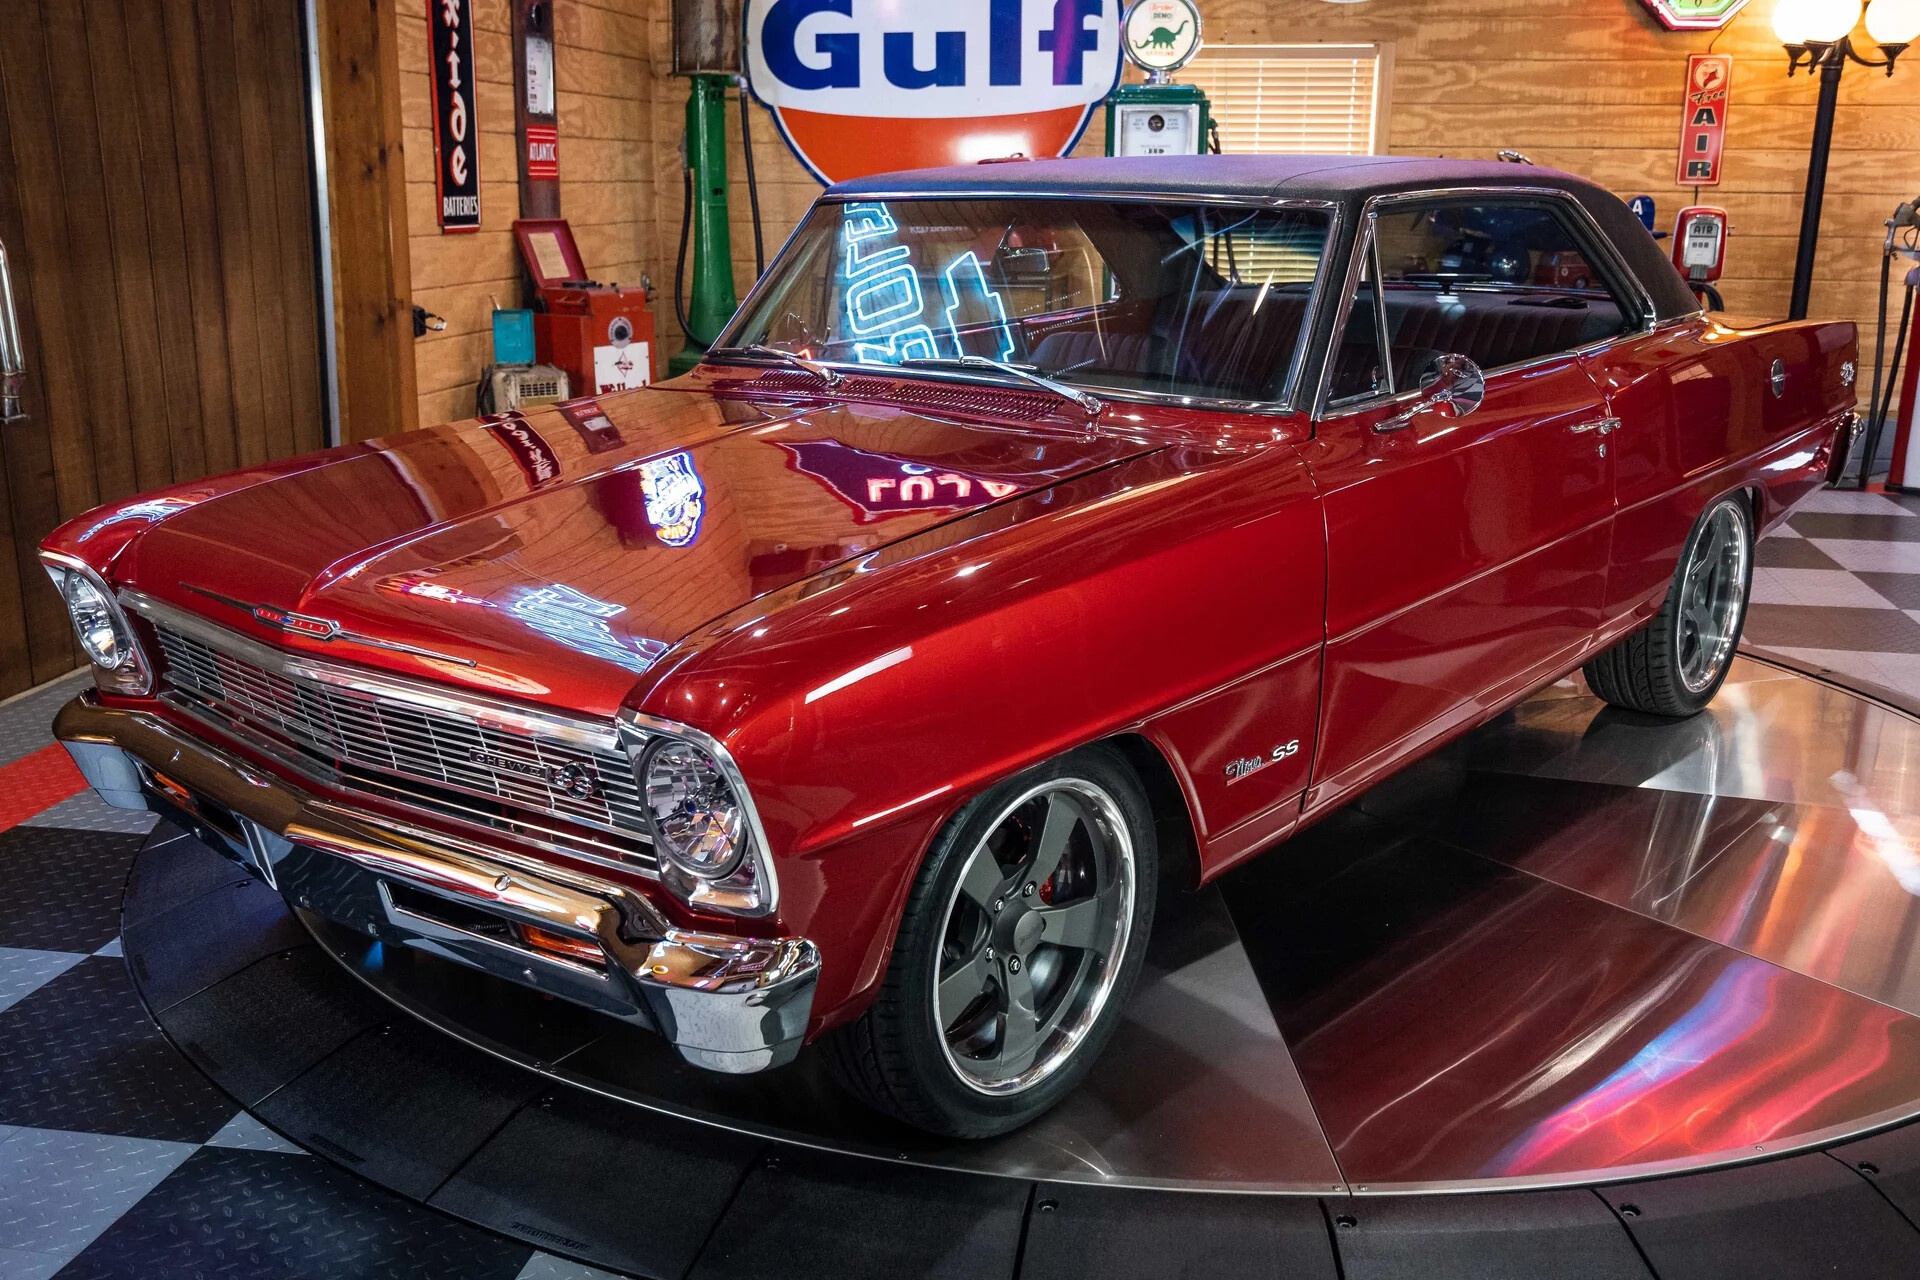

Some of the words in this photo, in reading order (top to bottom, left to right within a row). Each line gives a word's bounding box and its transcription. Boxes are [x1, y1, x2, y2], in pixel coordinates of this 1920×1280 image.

[761, 0, 1102, 90] Gulf
[1689, 90, 1726, 105] Free
[529, 142, 556, 161] ATLANTIC
[1687, 107, 1717, 179] AIR
[443, 195, 478, 217] BATTERIES
[1693, 225, 1714, 235] AIR
[1271, 739, 1299, 762] SS
[475, 753, 527, 773] CHEVY
